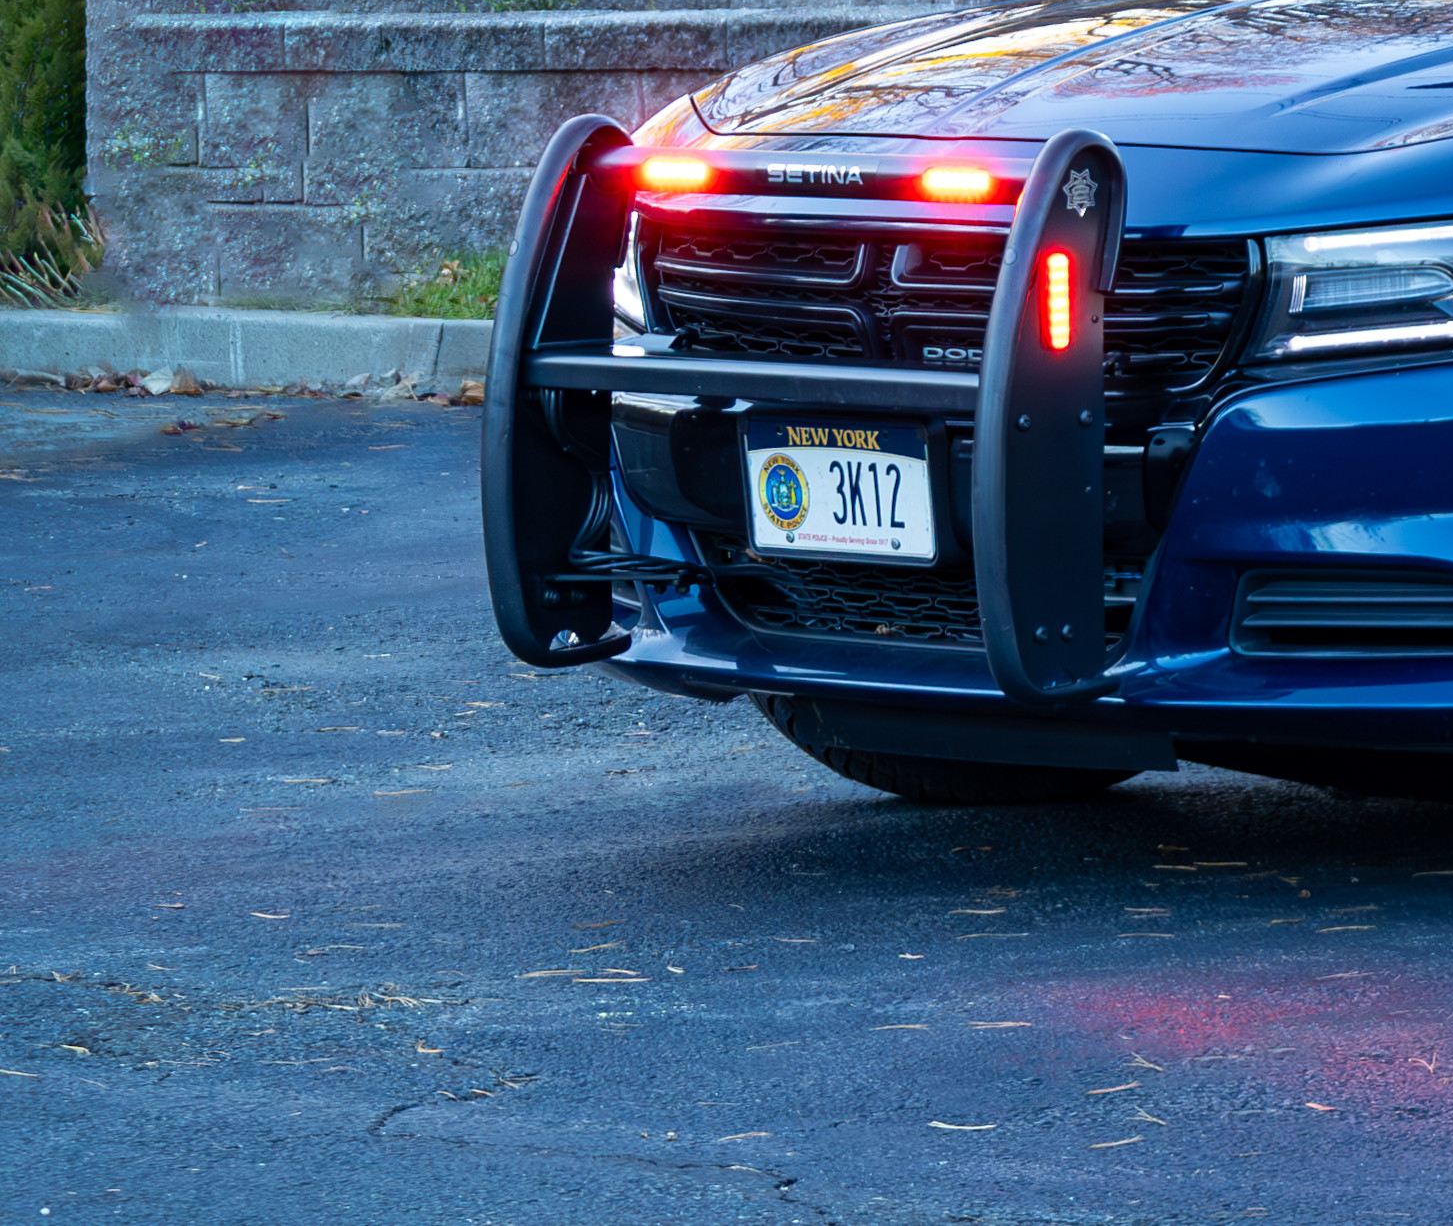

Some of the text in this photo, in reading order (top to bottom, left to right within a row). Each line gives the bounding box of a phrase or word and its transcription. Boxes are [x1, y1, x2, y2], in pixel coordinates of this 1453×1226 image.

[767, 163, 864, 185] SETINA
[923, 347, 984, 361] DOD
[786, 426, 881, 450] NEW YORK
[829, 460, 906, 529] 3K12
